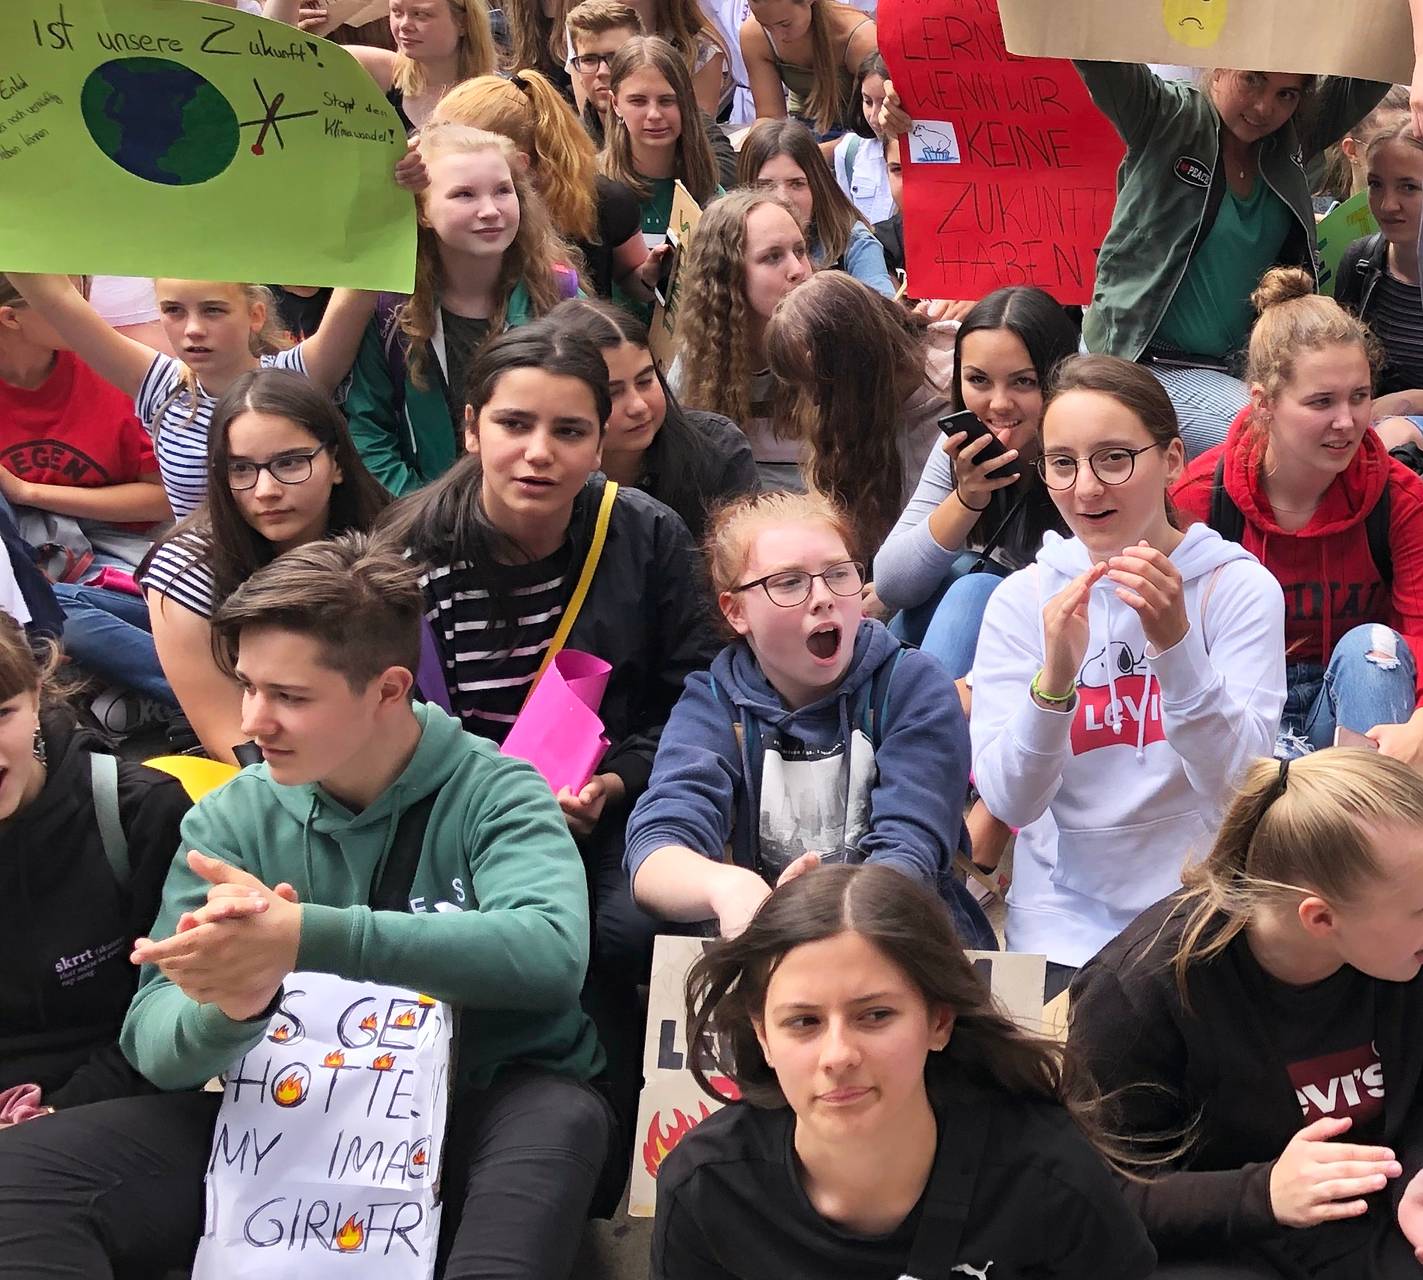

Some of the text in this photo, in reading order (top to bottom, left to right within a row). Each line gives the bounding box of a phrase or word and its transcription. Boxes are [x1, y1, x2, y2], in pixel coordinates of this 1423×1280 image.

[97, 30, 184, 52] unsere
[365, 104, 388, 117] den
[908, 70, 1071, 114] WENN WIR
[960, 117, 1083, 169] KEINE
[935, 180, 1113, 239] ZUKUNFT
[934, 240, 1084, 289] HABEN
[55, 948, 94, 973] skrrt
[230, 1054, 420, 1119] HOTTE
[209, 1123, 283, 1176] MY
